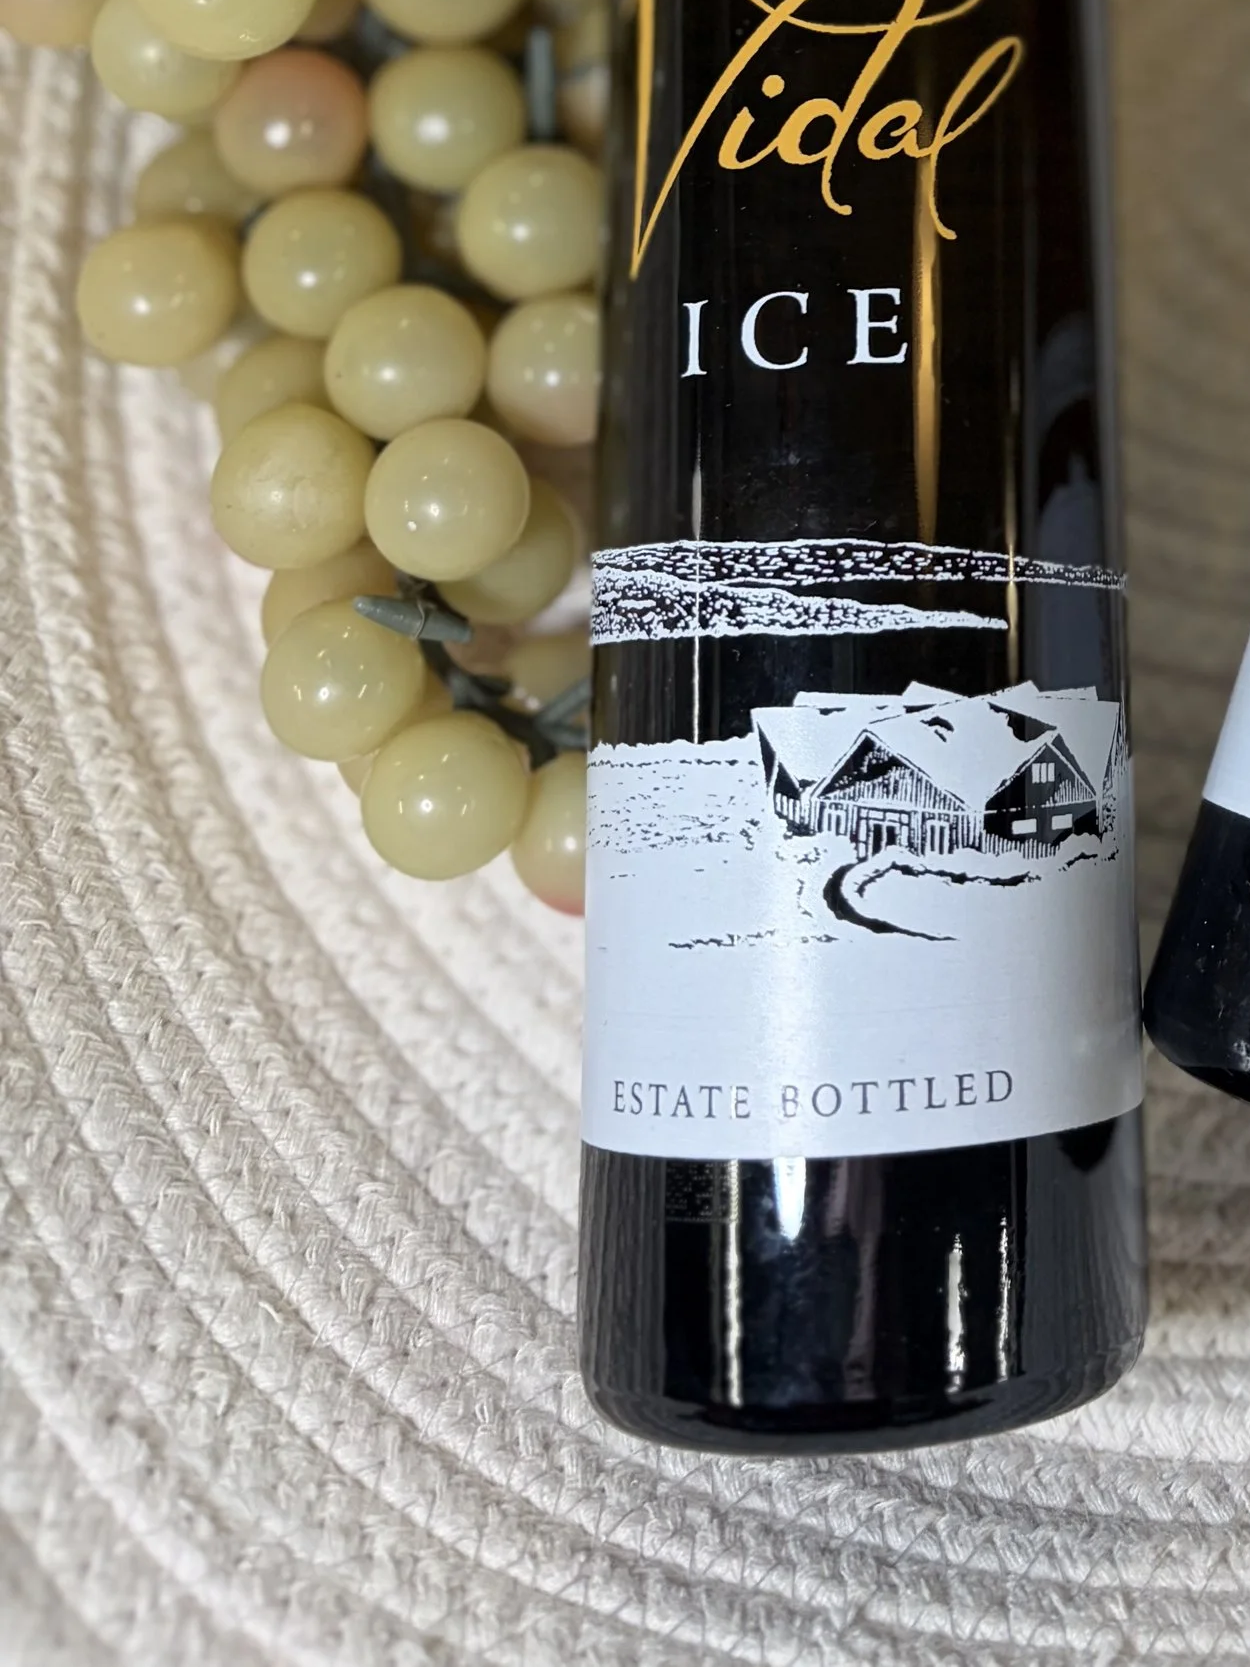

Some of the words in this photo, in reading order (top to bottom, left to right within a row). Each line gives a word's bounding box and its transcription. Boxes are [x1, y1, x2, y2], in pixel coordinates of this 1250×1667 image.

[681, 287, 909, 378] ICE
[613, 1080, 751, 1119] ESTATE
[781, 1069, 1014, 1118] BOTTLED
